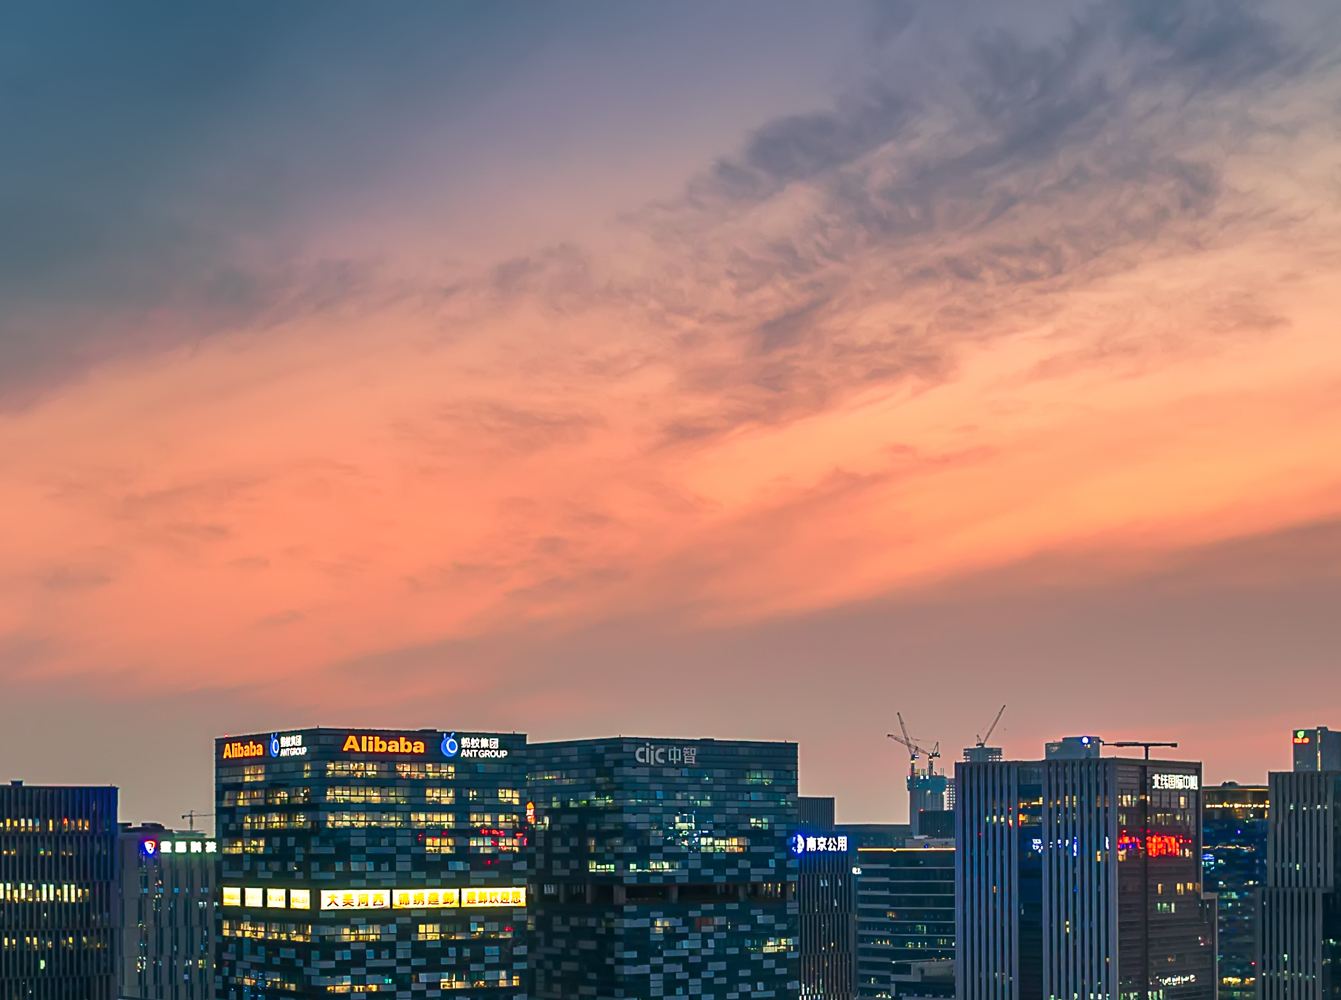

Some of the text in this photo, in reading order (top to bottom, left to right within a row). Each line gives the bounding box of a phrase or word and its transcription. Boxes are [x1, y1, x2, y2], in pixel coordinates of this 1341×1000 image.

[223, 741, 263, 759] Alibaba
[343, 735, 425, 753] Alibaba
[461, 737, 499, 749] 蚂蚁集团
[668, 746, 697, 764] 中智
[1152, 774, 1198, 790] 北纬国际中心
[806, 836, 848, 852] 南京公用
[326, 893, 385, 907] 大美河西
[398, 891, 455, 906] 锦绣建邺
[466, 890, 522, 905] 建邺欢迎您
